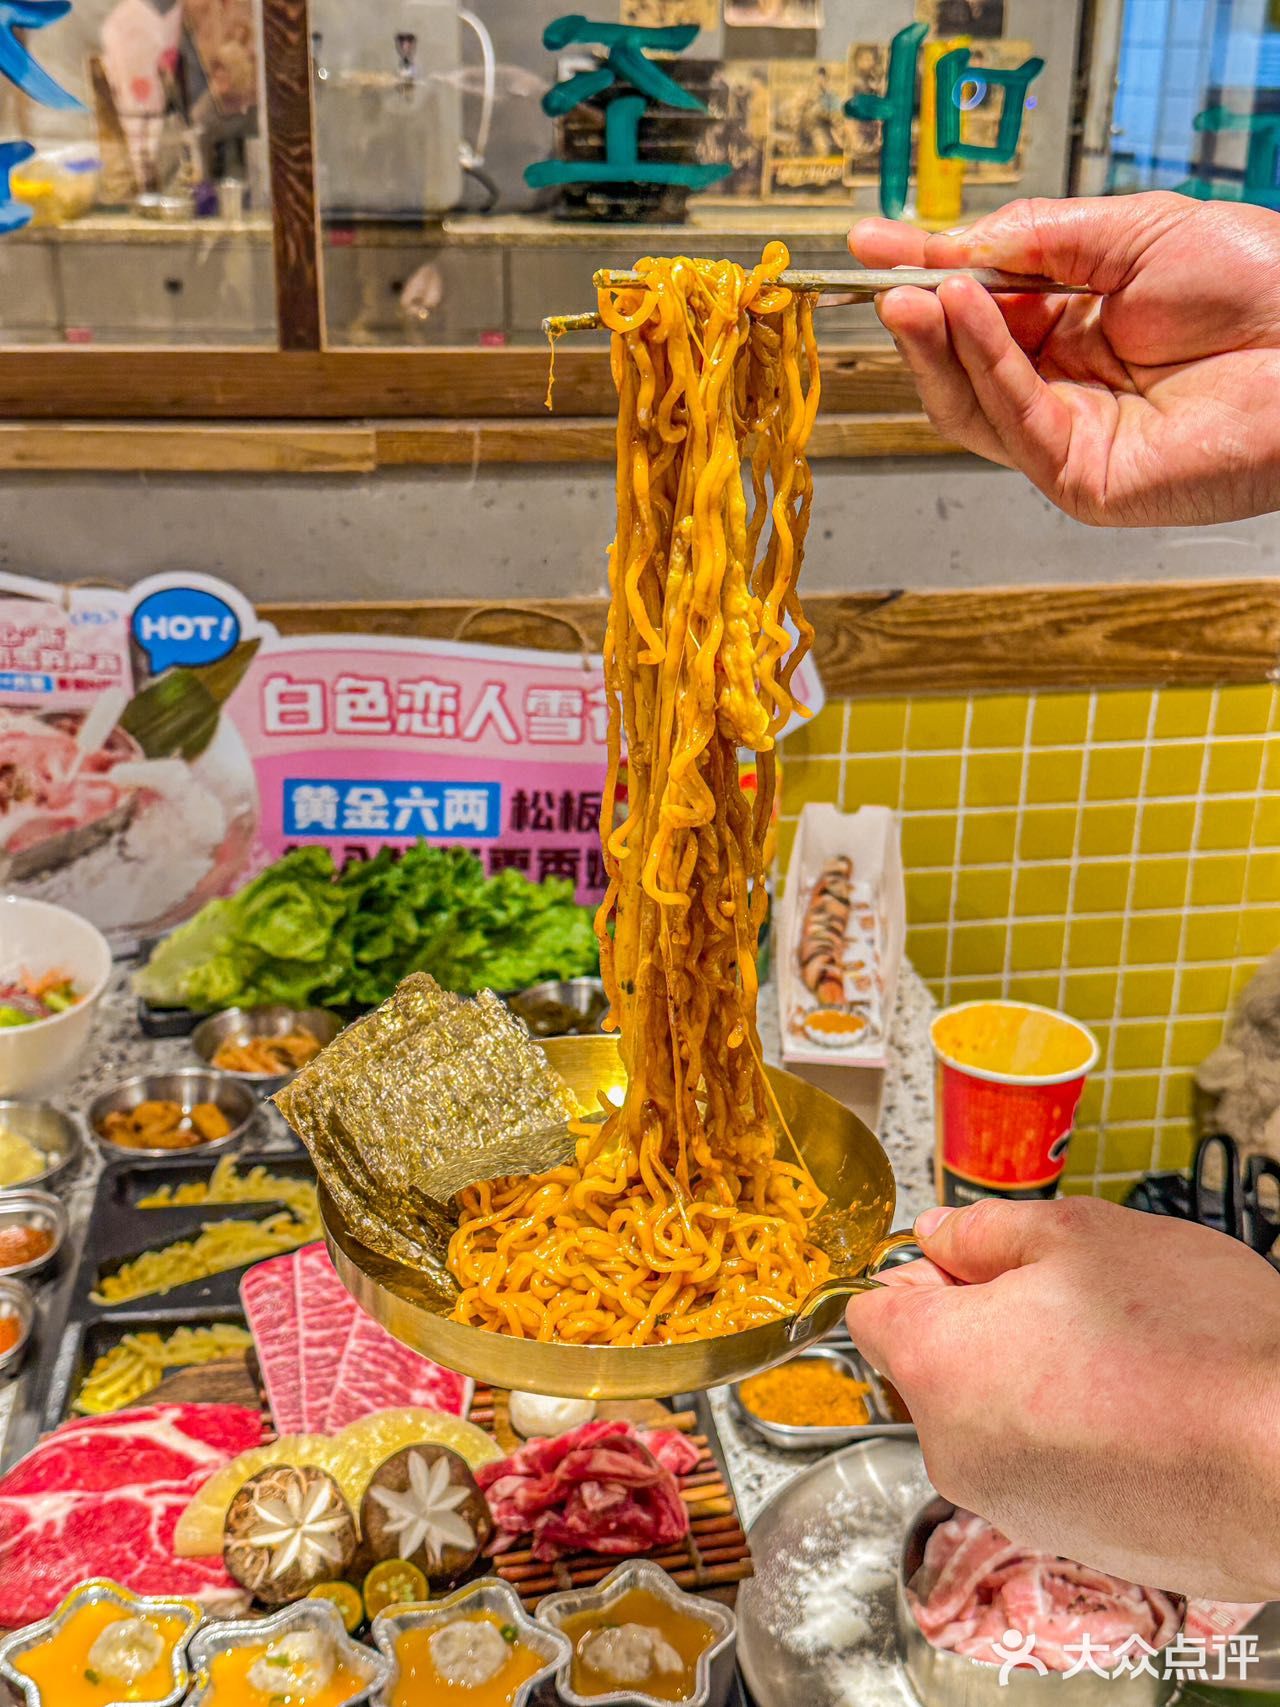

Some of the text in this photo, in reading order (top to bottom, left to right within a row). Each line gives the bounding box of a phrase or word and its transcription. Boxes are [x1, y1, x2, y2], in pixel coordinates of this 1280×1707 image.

[141, 615, 236, 642] HOT!
[291, 785, 490, 832] 黄金六两
